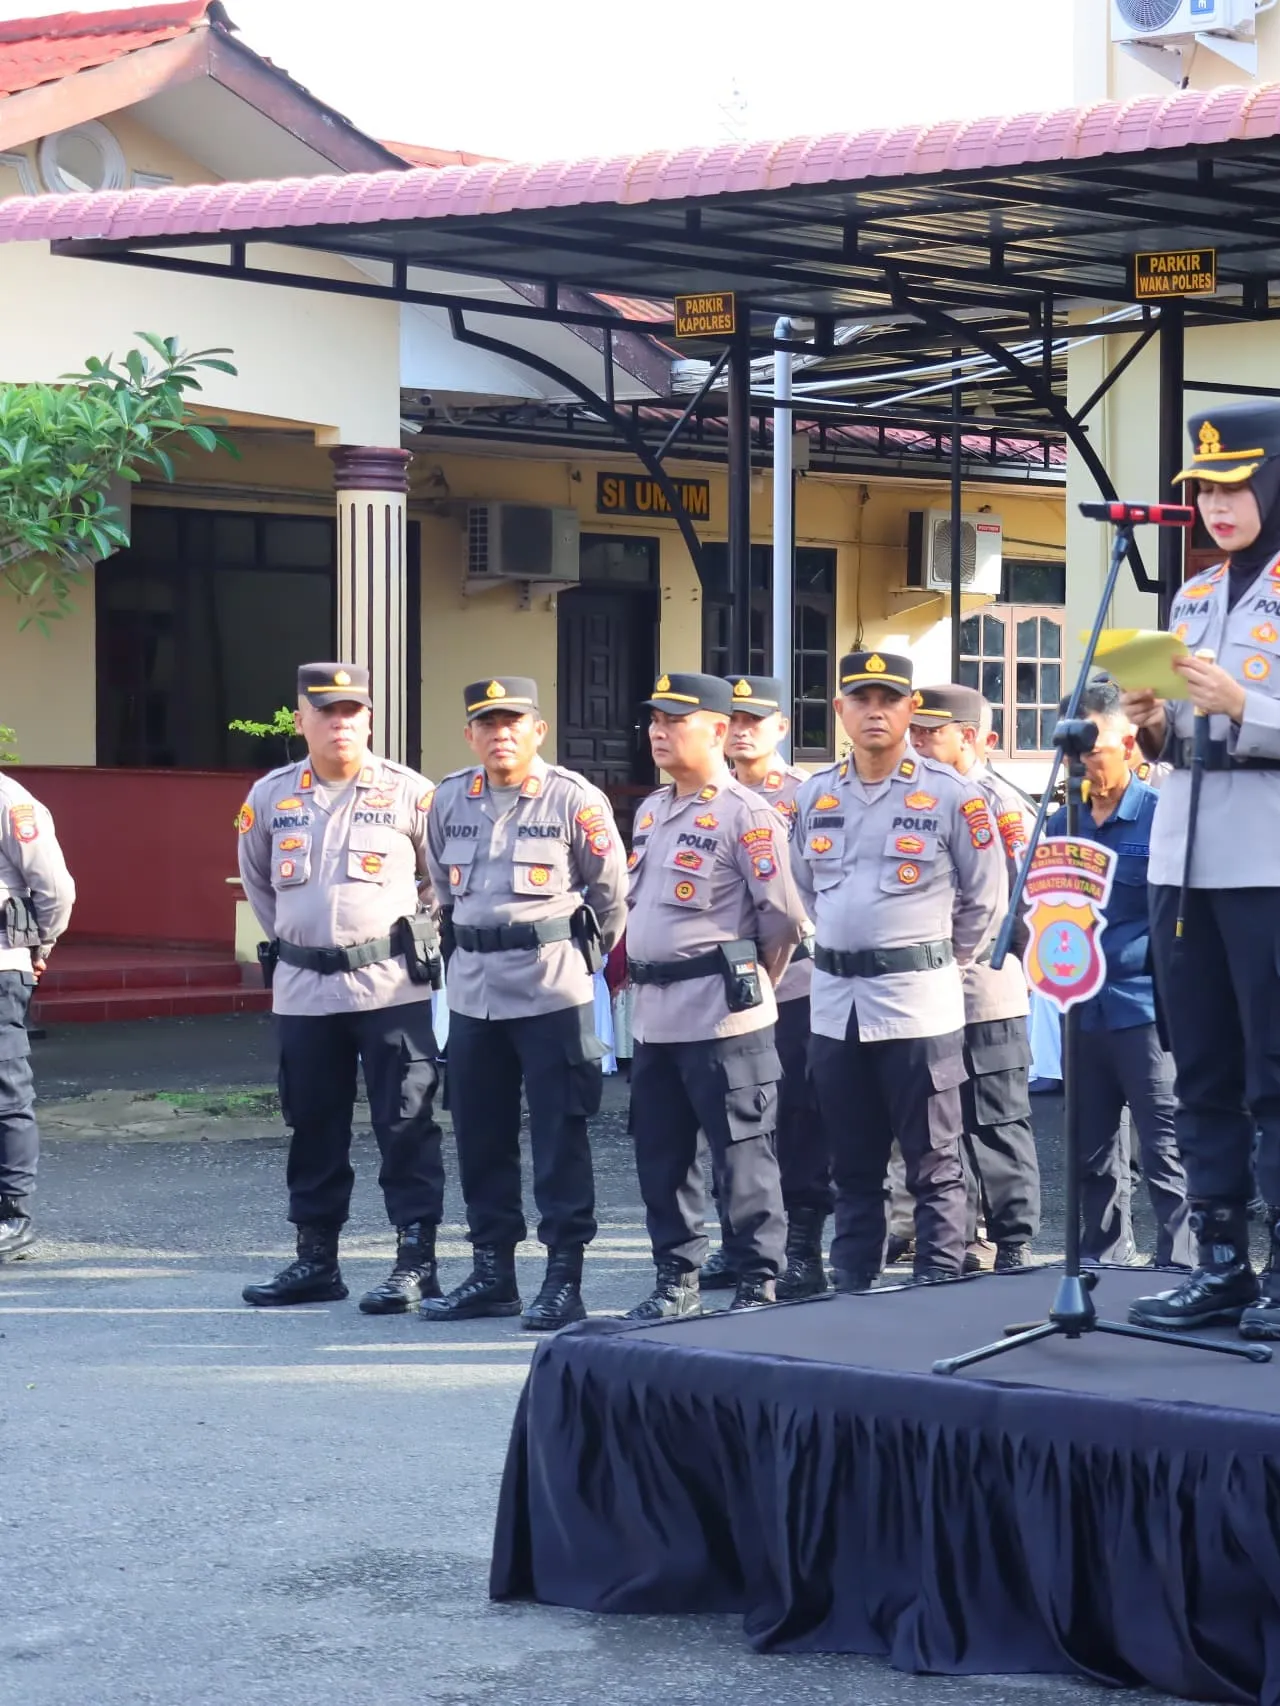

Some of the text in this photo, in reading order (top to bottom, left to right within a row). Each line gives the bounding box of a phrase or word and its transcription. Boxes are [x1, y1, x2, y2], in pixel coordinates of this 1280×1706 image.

[1150, 254, 1201, 273] PARKIR
[1140, 273, 1212, 293] WAKA POLRES
[686, 297, 724, 315] PARKIR
[679, 314, 732, 332] KAPOLRES
[602, 478, 626, 508] SI
[353, 811, 396, 825] POLRI
[892, 816, 938, 832] POLRI
[517, 825, 561, 838] POLRI
[676, 833, 718, 851] POLRI
[1032, 844, 1108, 868] OLRES
[1074, 877, 1102, 898] UTARA
